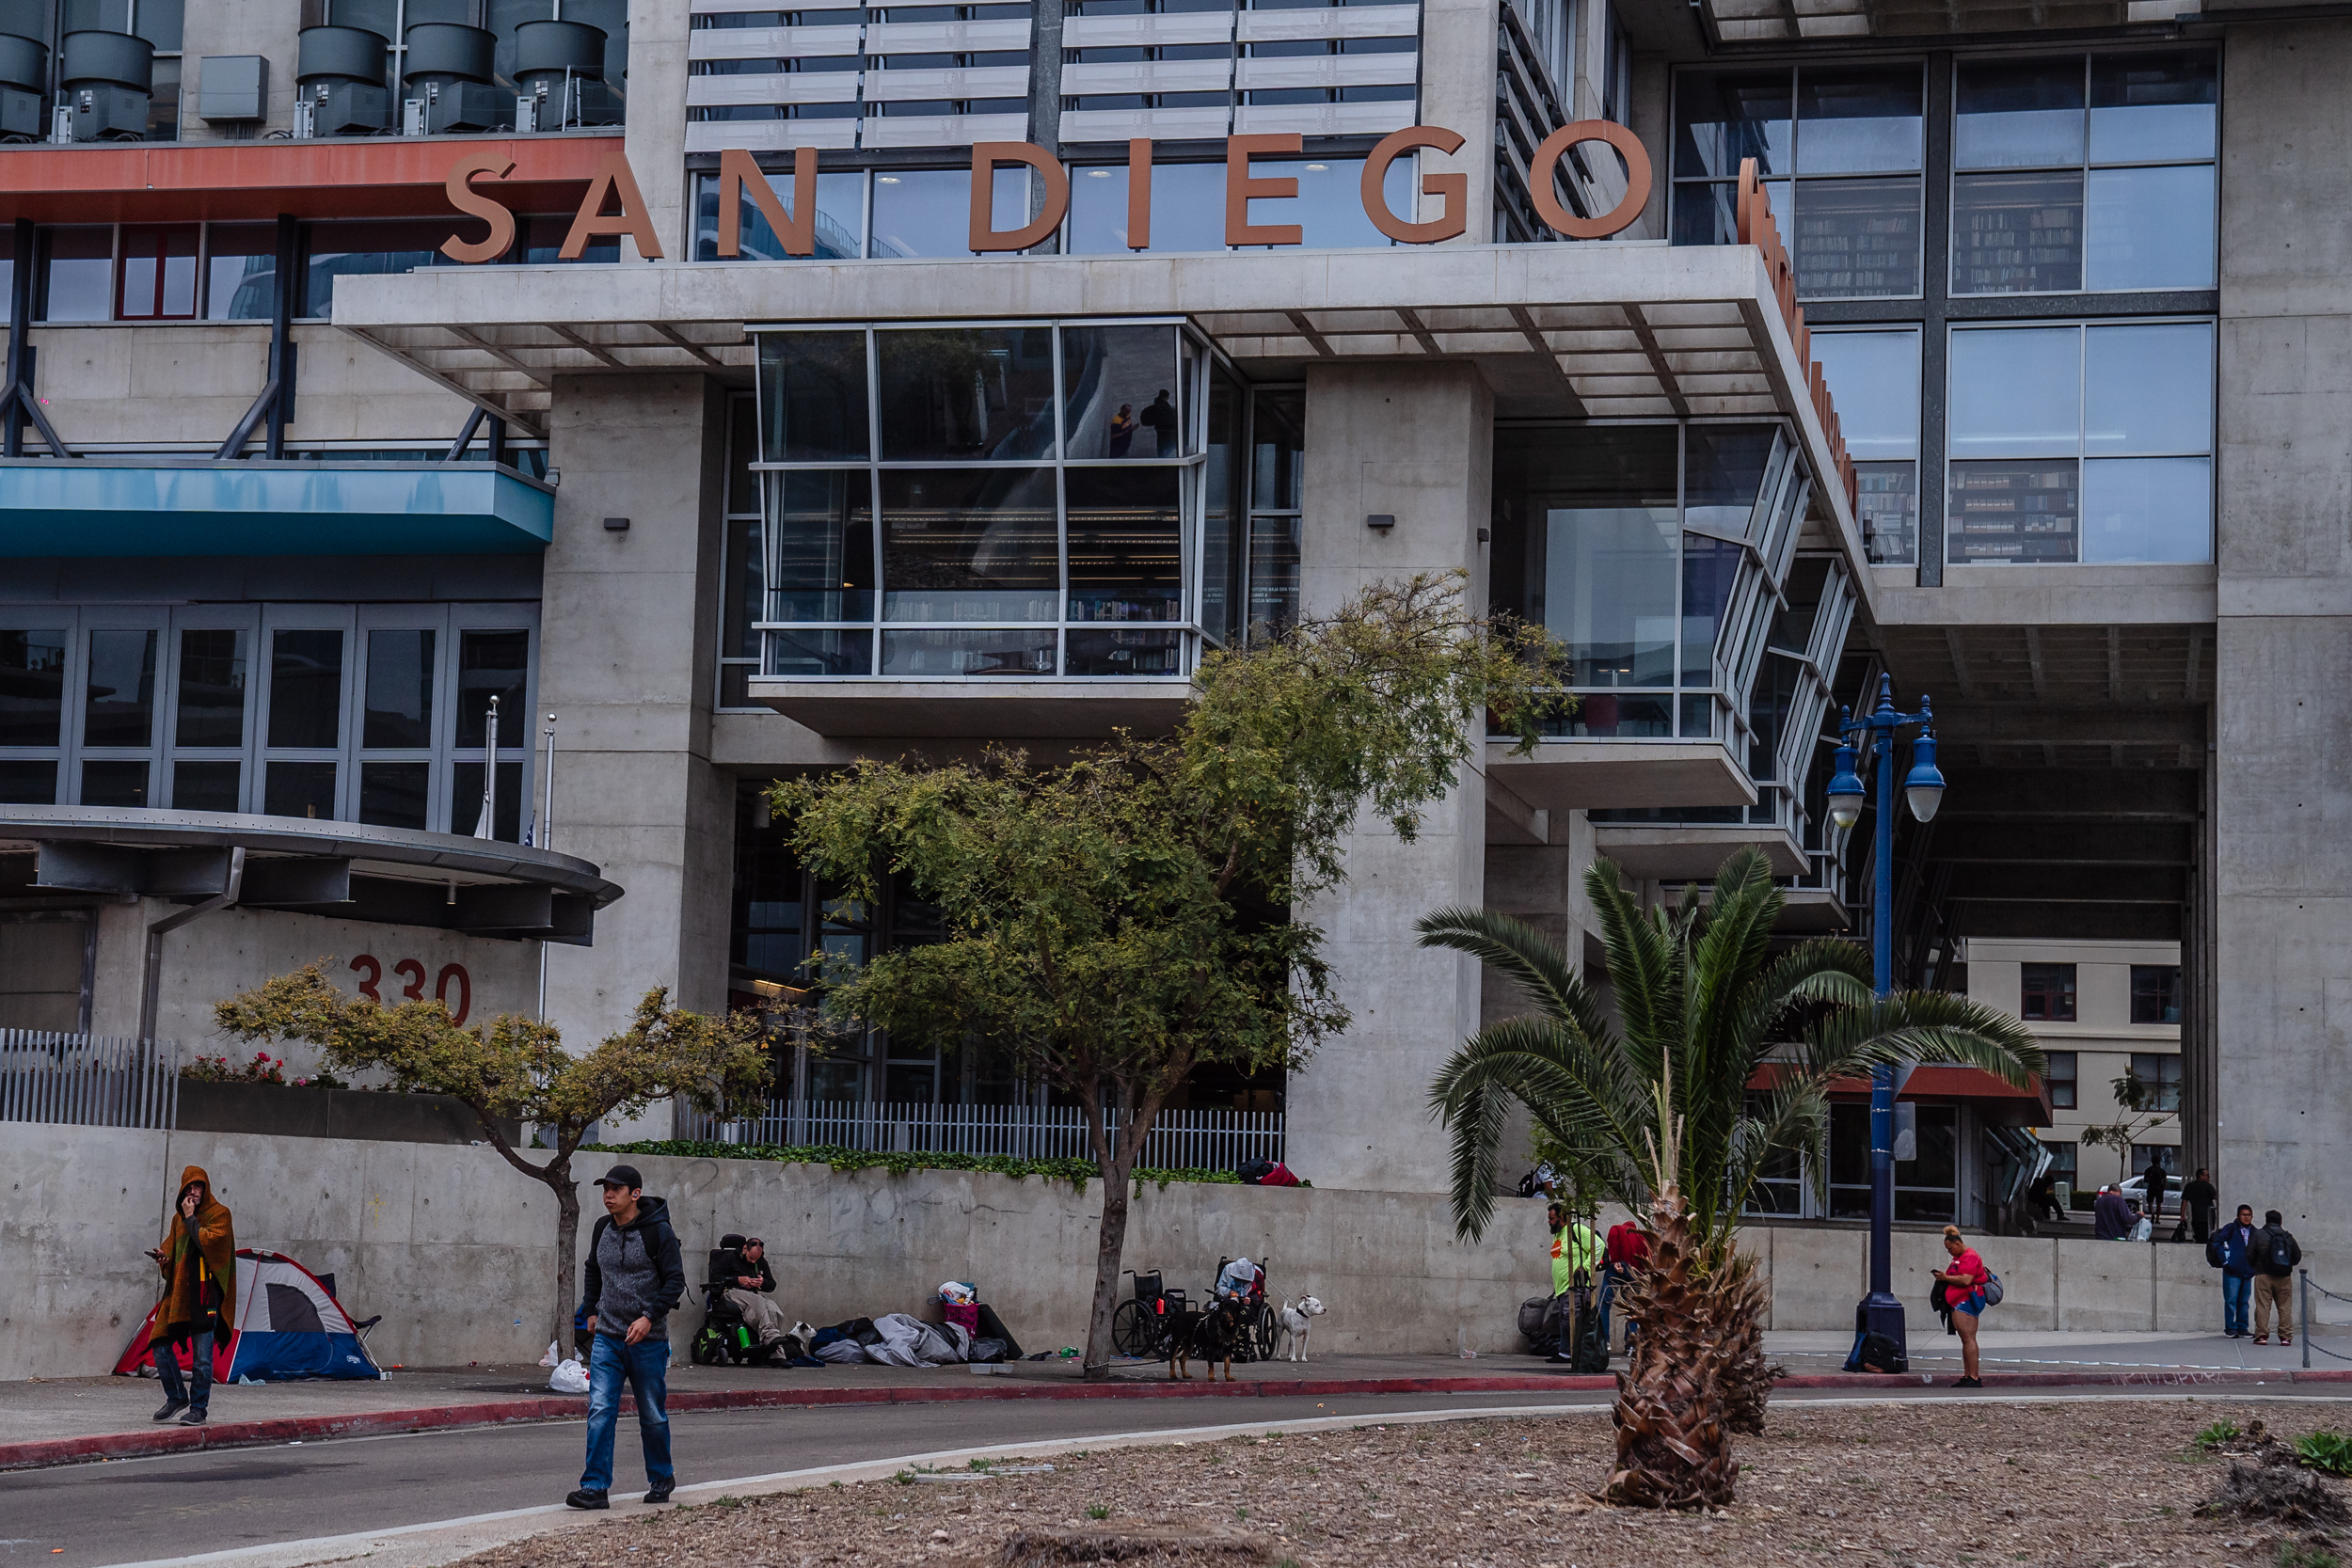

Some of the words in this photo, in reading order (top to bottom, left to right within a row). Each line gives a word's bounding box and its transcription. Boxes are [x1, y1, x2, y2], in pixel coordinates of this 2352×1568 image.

[439, 147, 818, 263] SAN
[968, 119, 1653, 253] DIEGO
[349, 954, 471, 1029] 330
